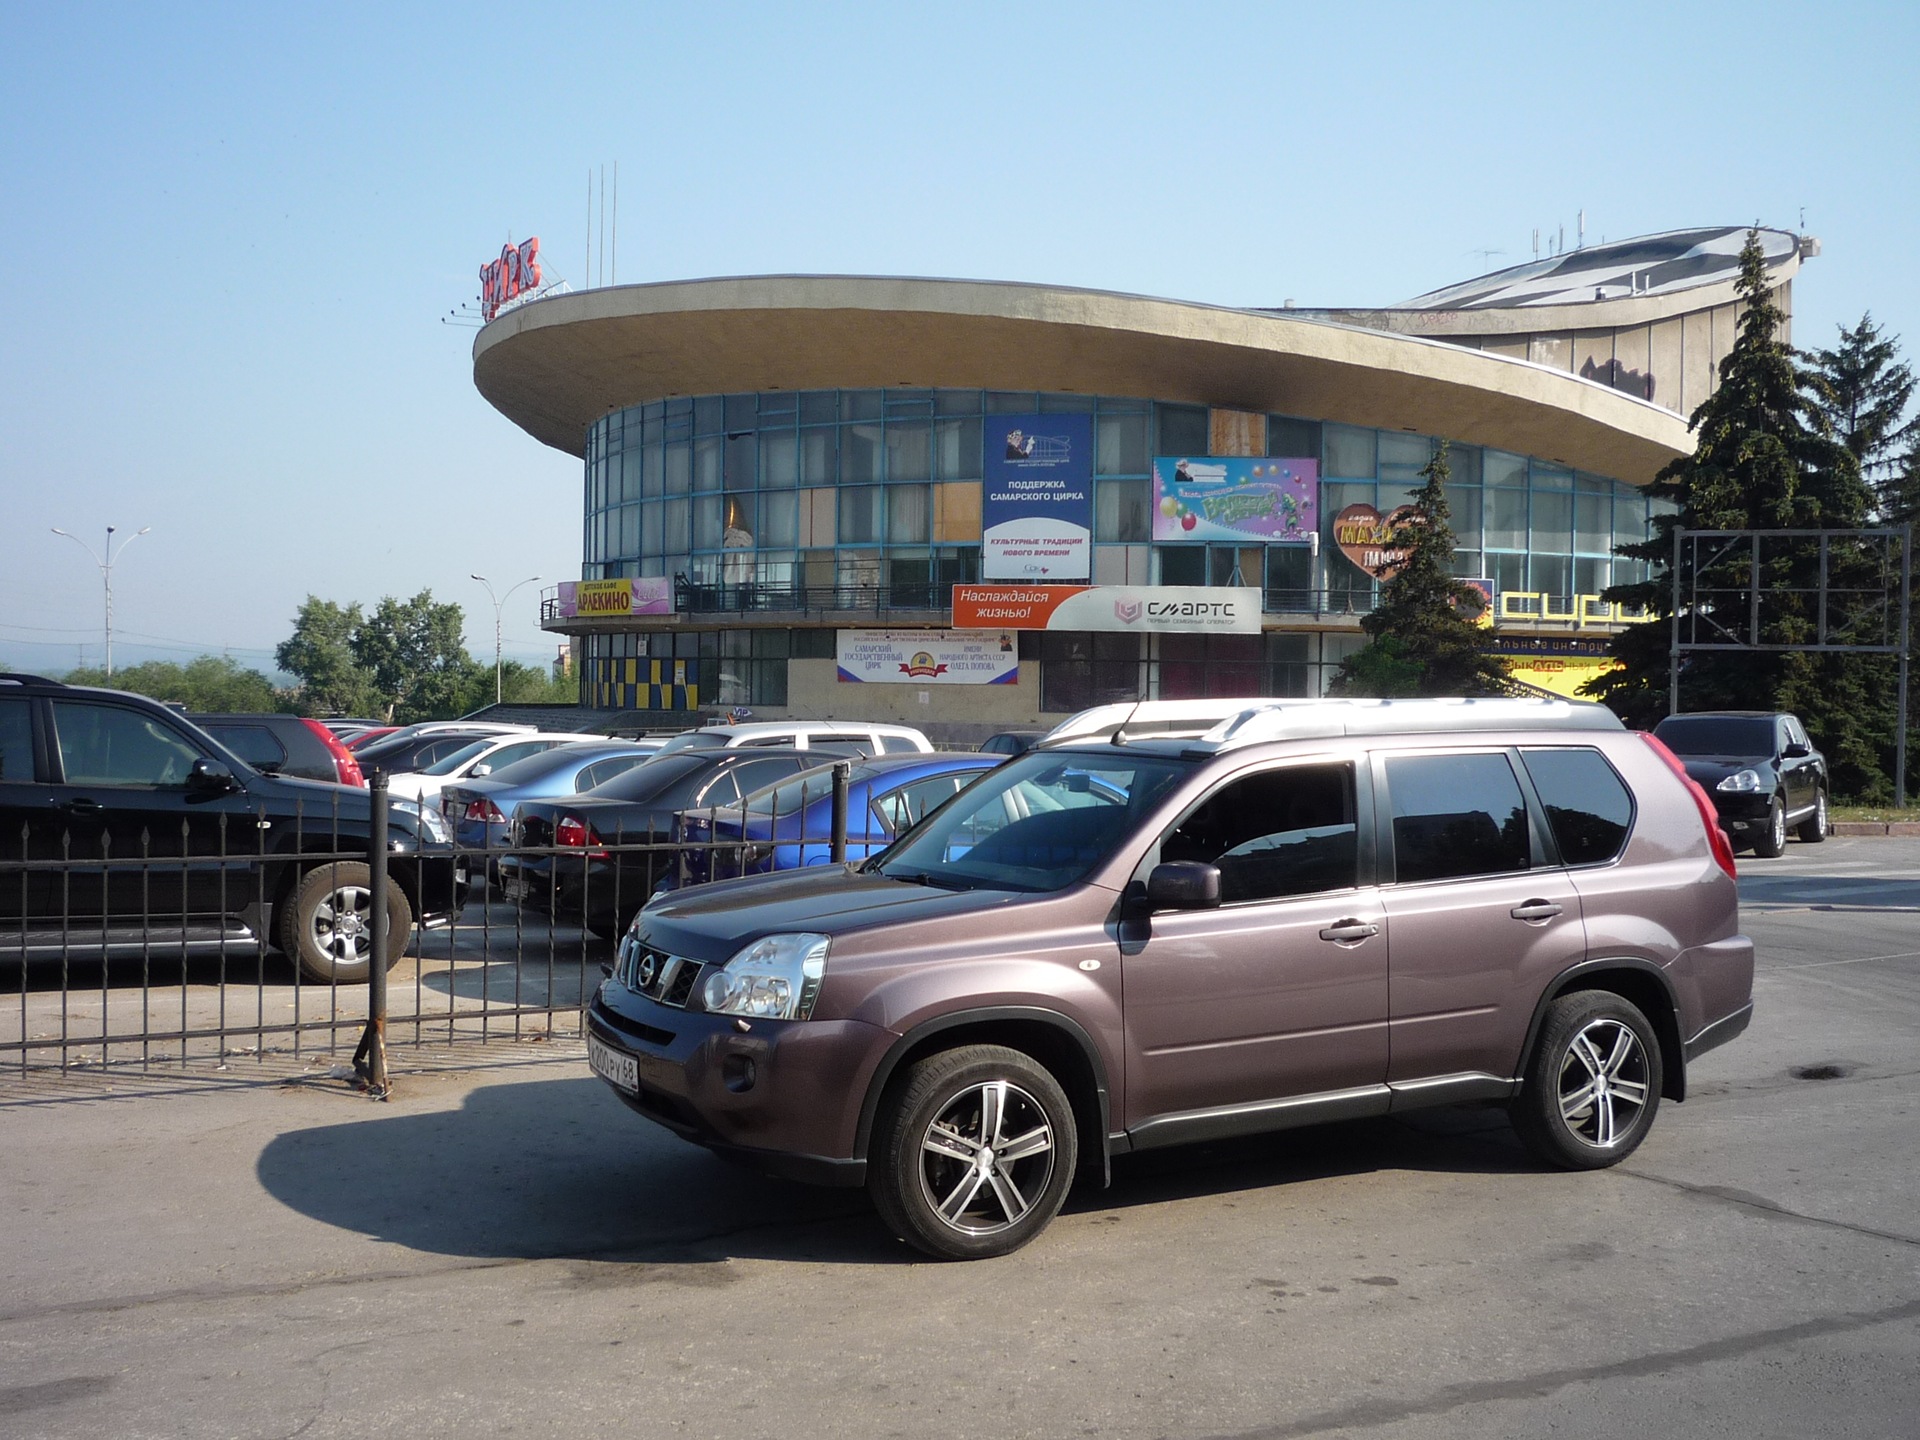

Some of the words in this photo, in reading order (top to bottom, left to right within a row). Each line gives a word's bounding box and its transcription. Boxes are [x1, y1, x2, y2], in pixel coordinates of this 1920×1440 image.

[479, 236, 541, 323] ЦИРК
[1008, 480, 1065, 489] ПОДДЕРЖКА
[990, 493, 1050, 501] САМАРСКОГО
[1053, 492, 1084, 502] ЦИРКА
[1043, 538, 1083, 547] ТРАДИЦИИ
[577, 591, 630, 612] АРЛЕКИНО
[960, 590, 1049, 603] Наслаждайся
[976, 606, 1032, 618] жизнью!
[854, 643, 892, 653] САМАРСКИЙ
[844, 652, 903, 662] ГОСУДАРСТВЕННЫЙ
[992, 653, 1006, 661] СССР
[865, 661, 882, 671] ЦИРК
[950, 661, 970, 671] ОЛЕГА
[970, 661, 996, 671] ПОПОВА
[734, 708, 748, 716] VIP
